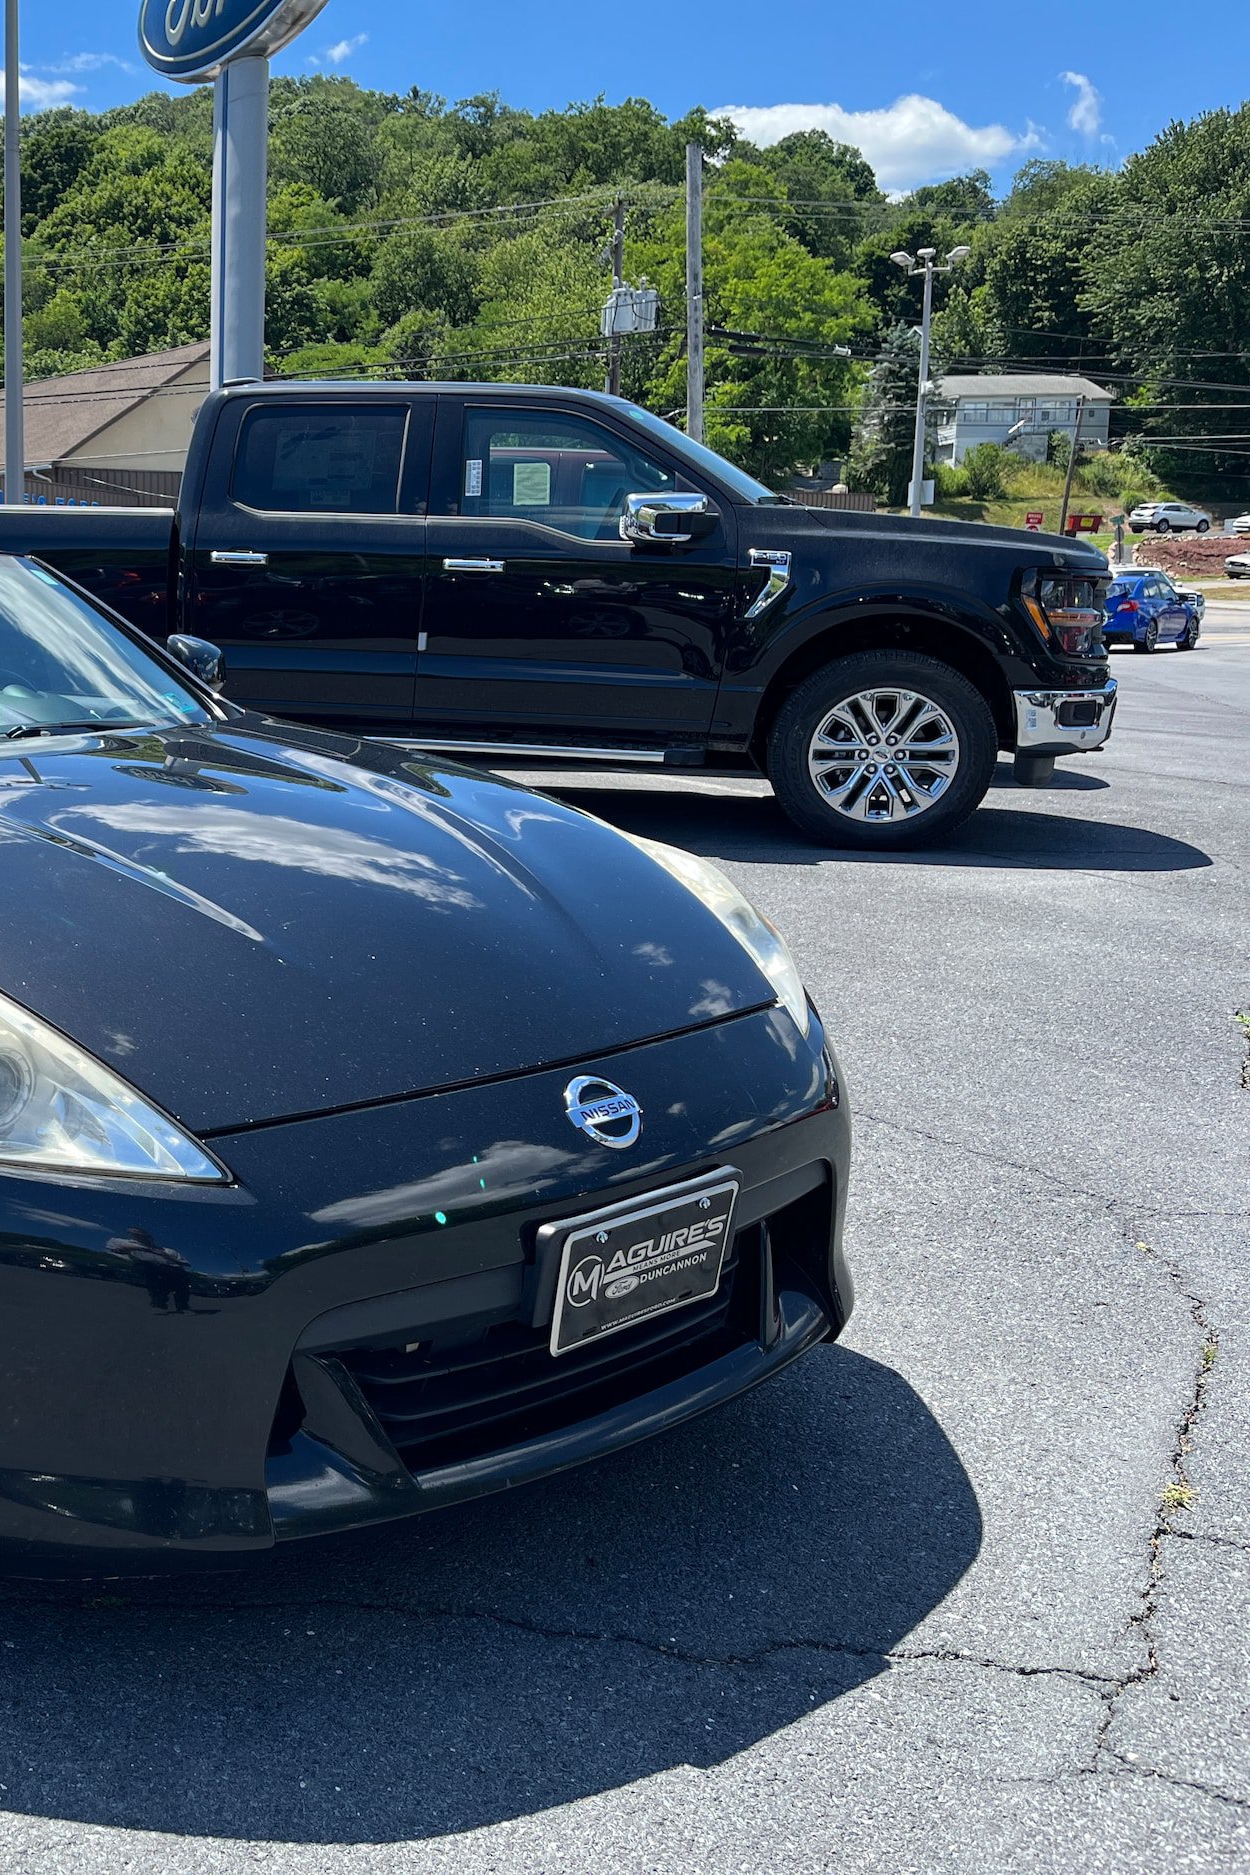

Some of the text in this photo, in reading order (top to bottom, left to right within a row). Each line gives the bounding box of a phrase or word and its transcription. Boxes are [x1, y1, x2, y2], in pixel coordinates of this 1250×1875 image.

[580, 1097, 636, 1122] NISSAN
[632, 1250, 681, 1272] MEANS MORE
[640, 1252, 707, 1284] DUNCANNON
